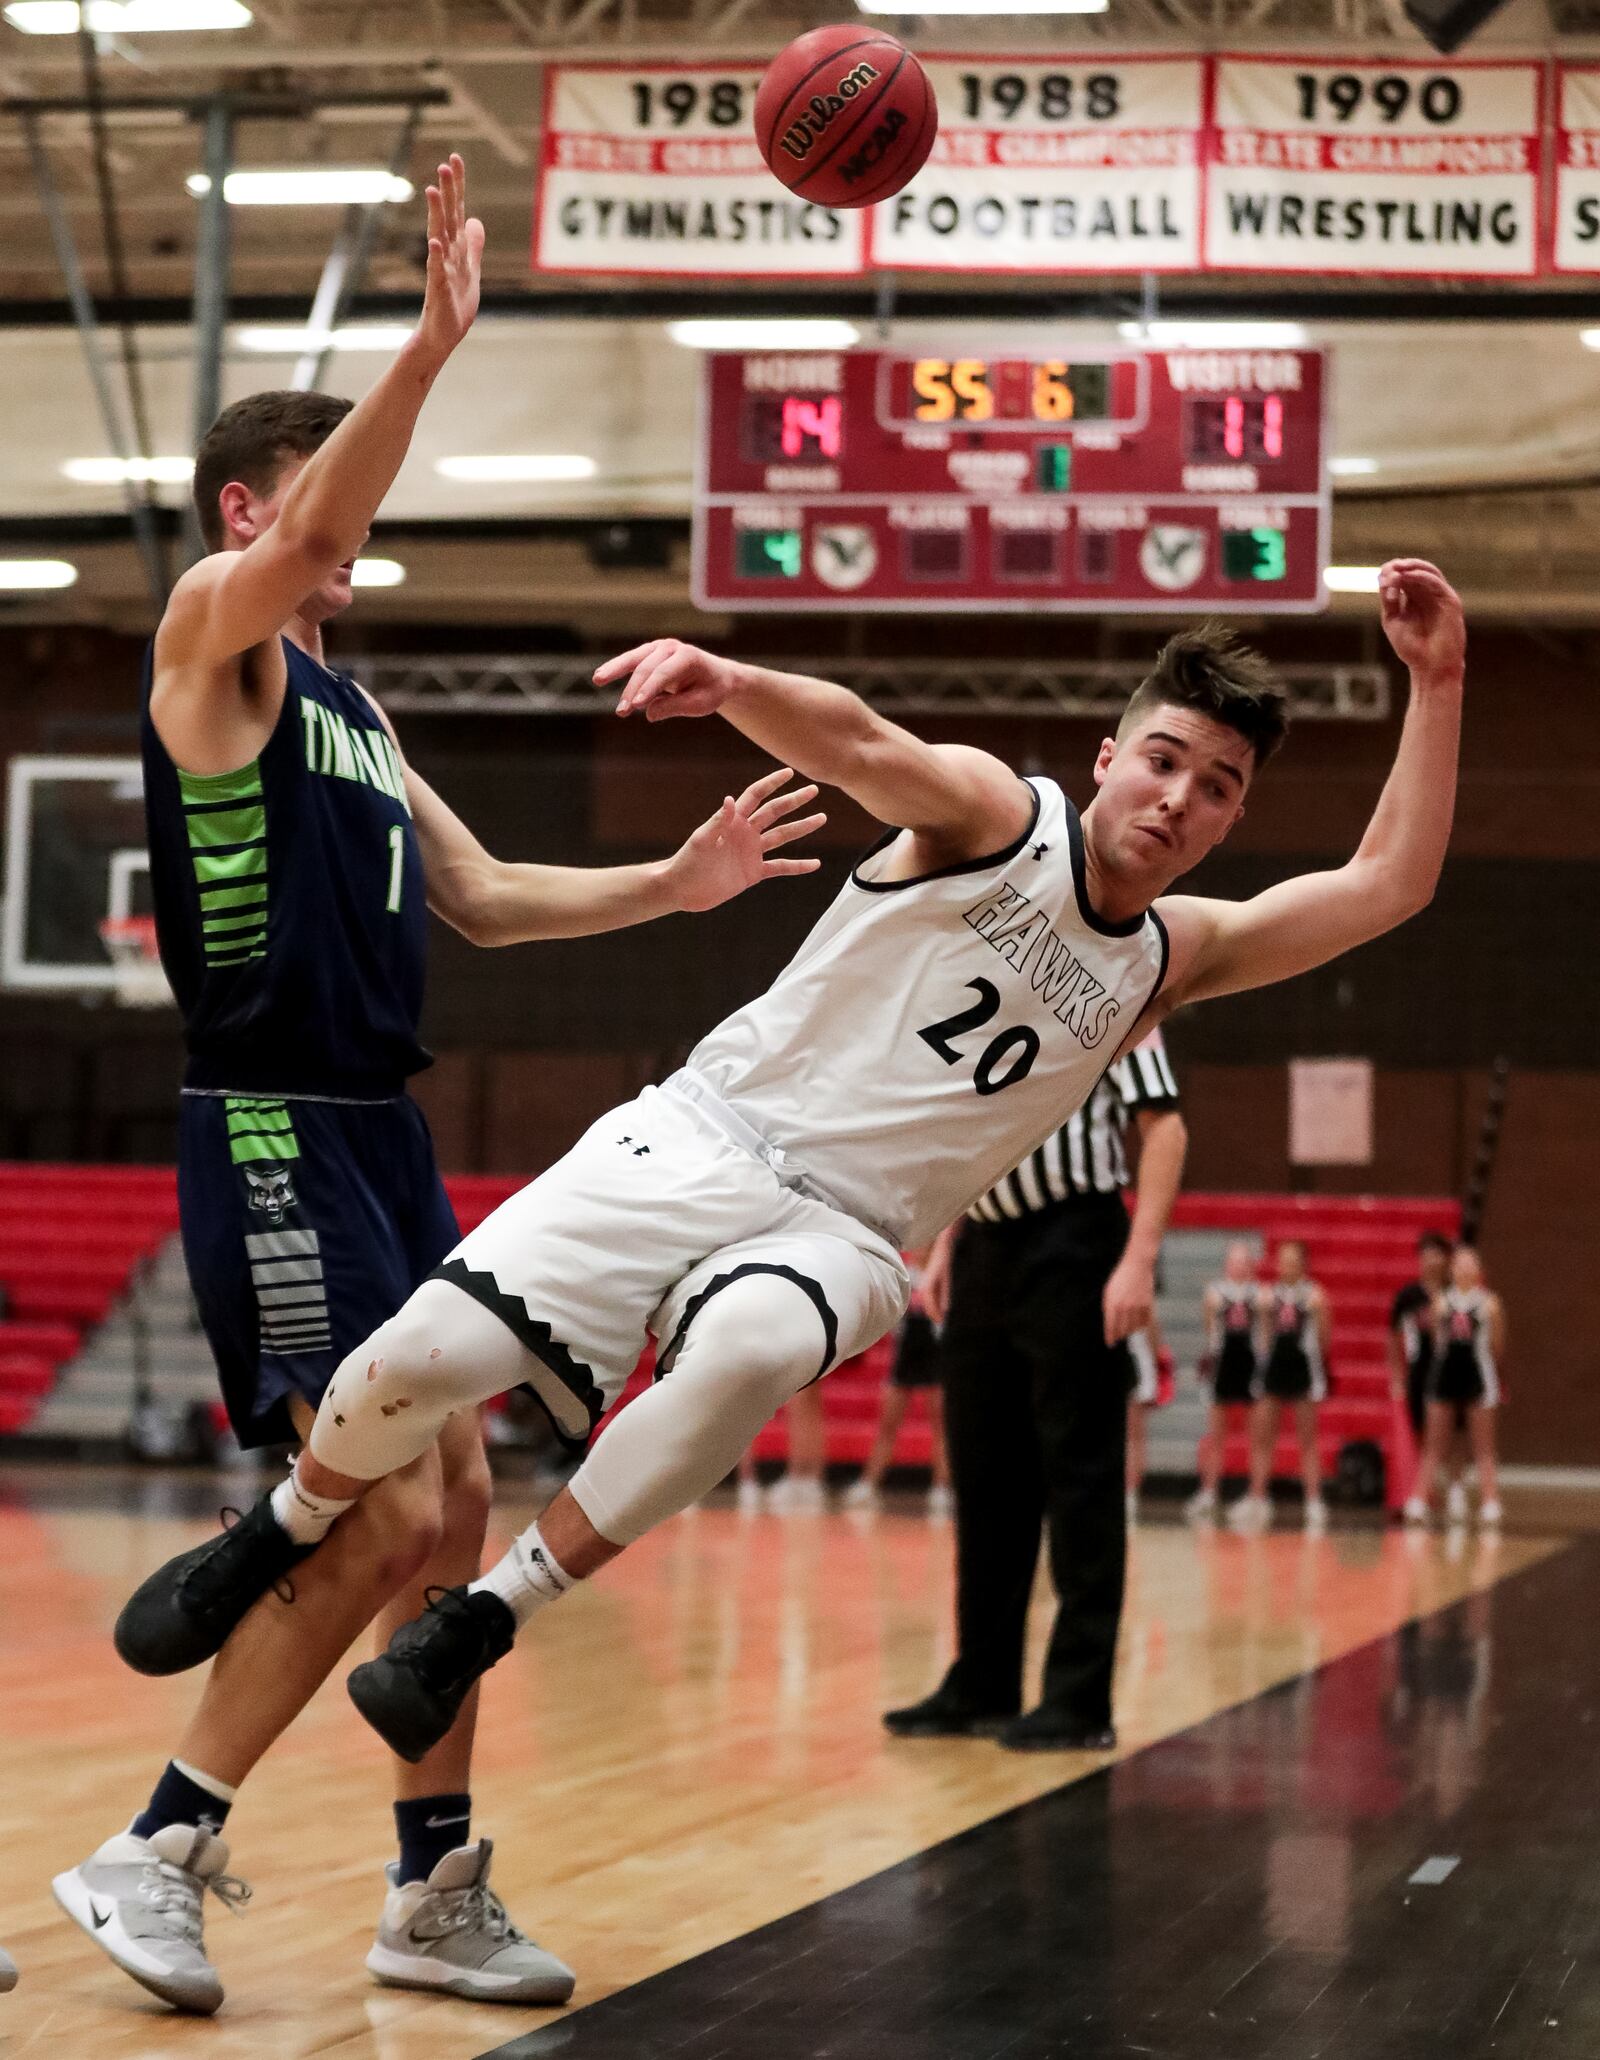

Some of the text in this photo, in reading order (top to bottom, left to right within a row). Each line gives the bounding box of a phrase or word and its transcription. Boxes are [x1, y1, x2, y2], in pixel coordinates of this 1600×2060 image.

[631, 79, 760, 127] 198
[780, 62, 880, 160] Wilson
[961, 74, 1119, 120] 1988
[1296, 74, 1462, 124] 1990
[837, 107, 908, 184] NCAA
[559, 197, 840, 242] GYMNASTICS
[894, 194, 1180, 238] FOOTBALL
[1228, 194, 1517, 243] WRESTLING
[1574, 196, 1600, 241] S
[912, 358, 994, 422] 55
[781, 396, 843, 458] 14
[1223, 395, 1283, 458] 11
[763, 530, 801, 578] 4
[1250, 527, 1287, 581] 3
[386, 824, 403, 913] 1
[962, 882, 1120, 1049] HAWKS
[915, 976, 1040, 1096] 20
